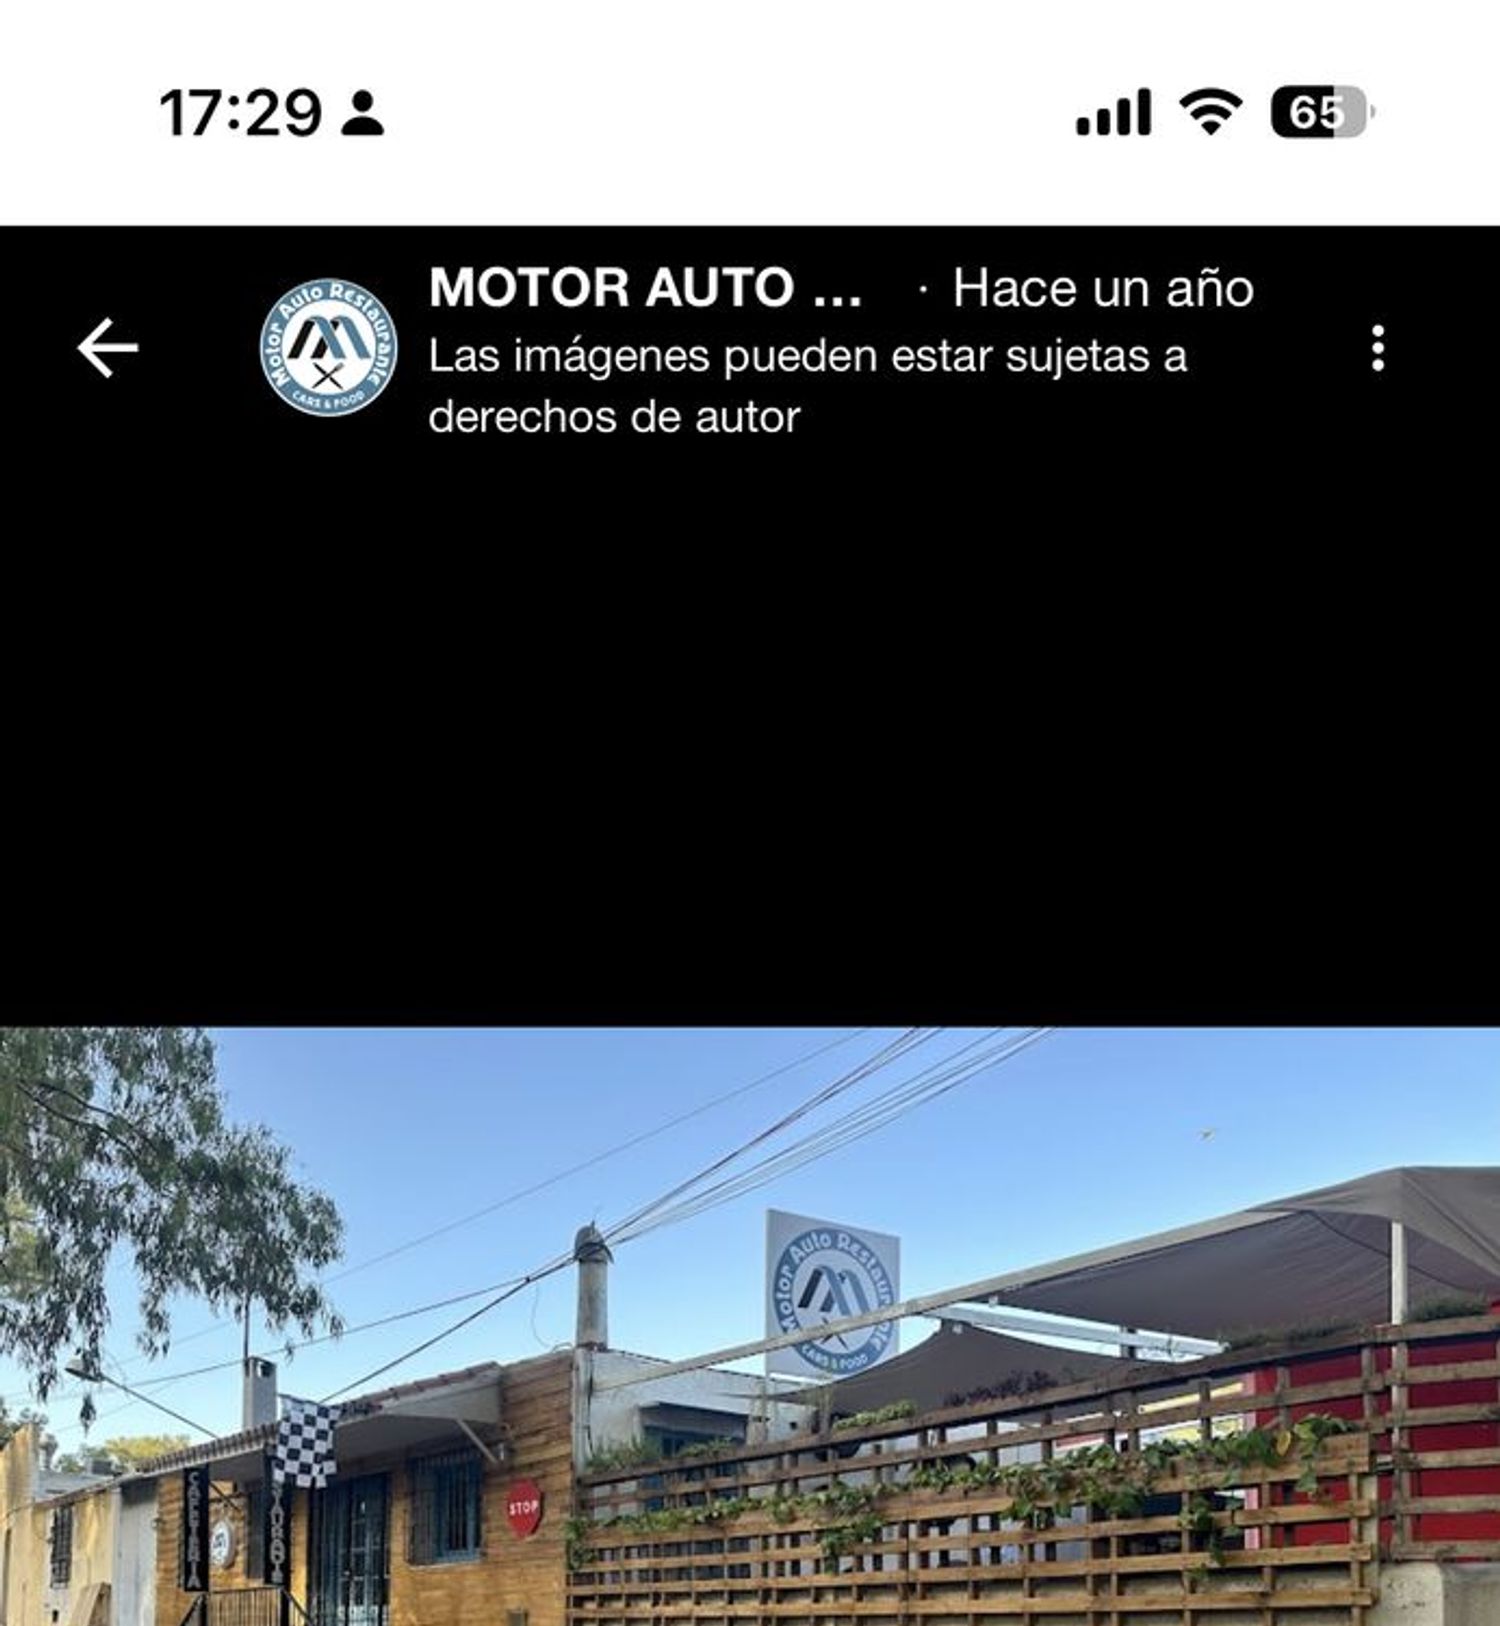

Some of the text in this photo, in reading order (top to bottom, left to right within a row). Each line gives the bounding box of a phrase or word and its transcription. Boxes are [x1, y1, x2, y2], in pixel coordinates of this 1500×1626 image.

[777, 1263, 799, 1330] Motor
[790, 1232, 832, 1264] Auto
[509, 1500, 539, 1517] STOP
